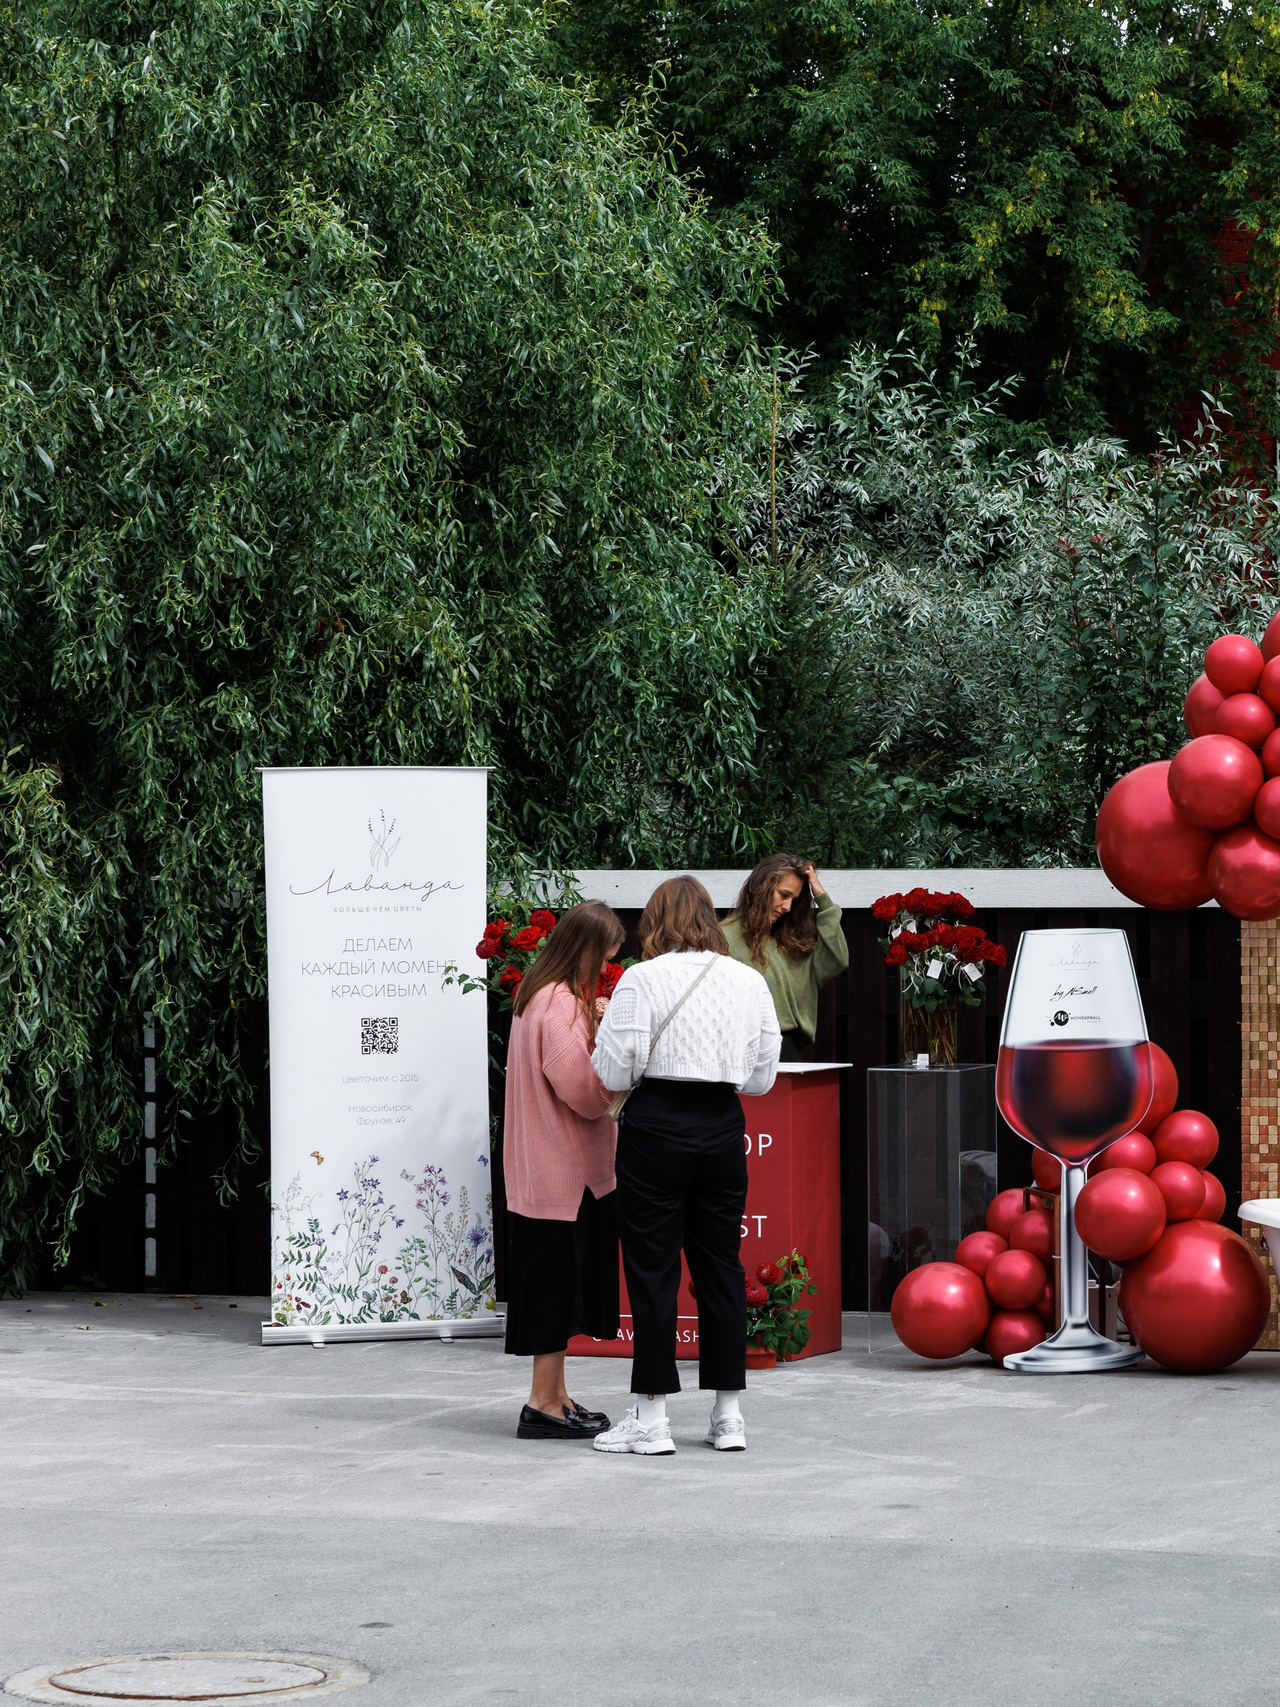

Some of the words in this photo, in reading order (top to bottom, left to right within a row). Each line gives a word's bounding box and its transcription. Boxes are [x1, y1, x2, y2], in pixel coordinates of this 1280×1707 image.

[289, 869, 465, 902] Лаванда
[393, 905, 422, 913] ЦВЕТЫ
[343, 937, 413, 954] ДЕЛАЕМ
[301, 958, 376, 977] КАЖДЫЙ
[381, 959, 457, 975] МОМЕНТ
[331, 983, 428, 999] КРАСИВЫМ
[342, 1076, 389, 1084] цветочим
[400, 1074, 419, 1082] 2015
[395, 1116, 406, 1124] 49
